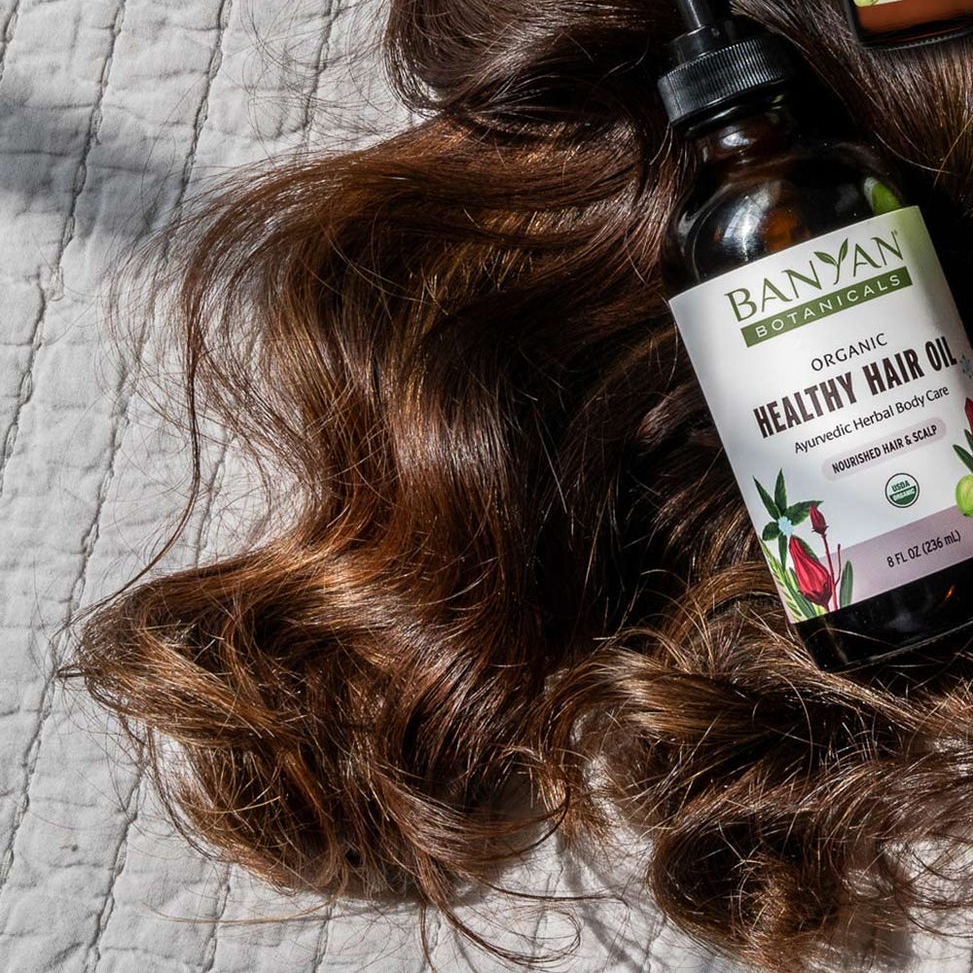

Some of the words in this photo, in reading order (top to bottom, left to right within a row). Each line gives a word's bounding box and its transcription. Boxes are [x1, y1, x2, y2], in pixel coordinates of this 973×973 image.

[724, 235, 904, 322] BANYAN
[755, 273, 901, 338] BOTANICALS
[811, 333, 887, 371] ORGANIC
[752, 371, 857, 439] HEALTHY
[862, 348, 925, 396] HAIR
[924, 336, 958, 371] OIL
[794, 423, 852, 454] Ayurvedic
[852, 406, 894, 430] Herbal
[895, 394, 925, 414] Body
[926, 386, 949, 402] Care
[832, 447, 881, 474] NOURISHED
[882, 438, 904, 455] HAIR
[905, 435, 913, 445] &
[912, 424, 937, 443] SCALP
[891, 480, 911, 492] USDA
[887, 556, 895, 567] 8
[894, 552, 908, 565] FL
[908, 545, 922, 559] OZ
[922, 537, 943, 555] (236
[944, 530, 961, 545] mL)
